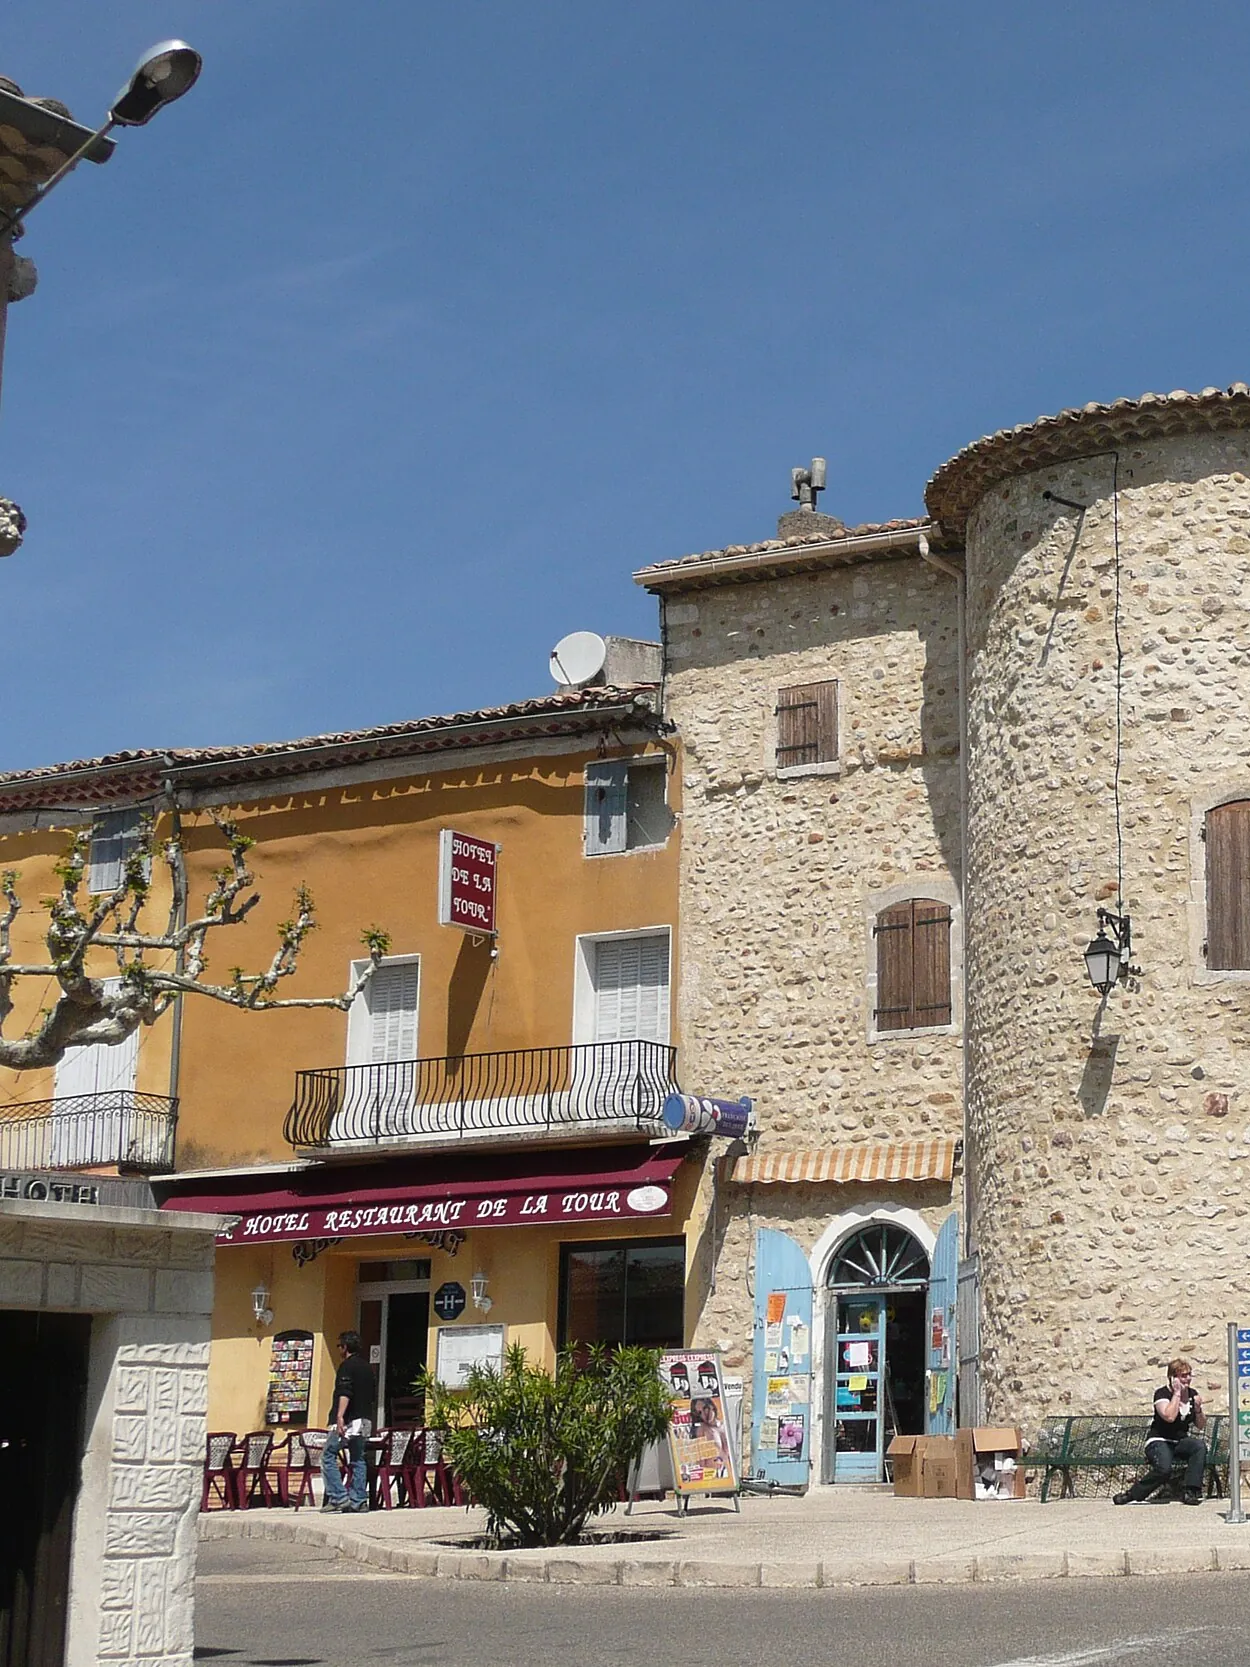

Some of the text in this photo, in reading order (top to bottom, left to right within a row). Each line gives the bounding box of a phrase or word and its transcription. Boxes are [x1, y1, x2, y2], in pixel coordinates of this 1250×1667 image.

[453, 839, 494, 865] HOTEL
[452, 867, 492, 892] DE LA
[453, 897, 489, 922] TOUR
[243, 1212, 309, 1236] HOTEL
[323, 1200, 466, 1231] RESTAURANT
[476, 1198, 508, 1218] DE
[520, 1195, 548, 1215] LA
[562, 1191, 621, 1213] TOUR
